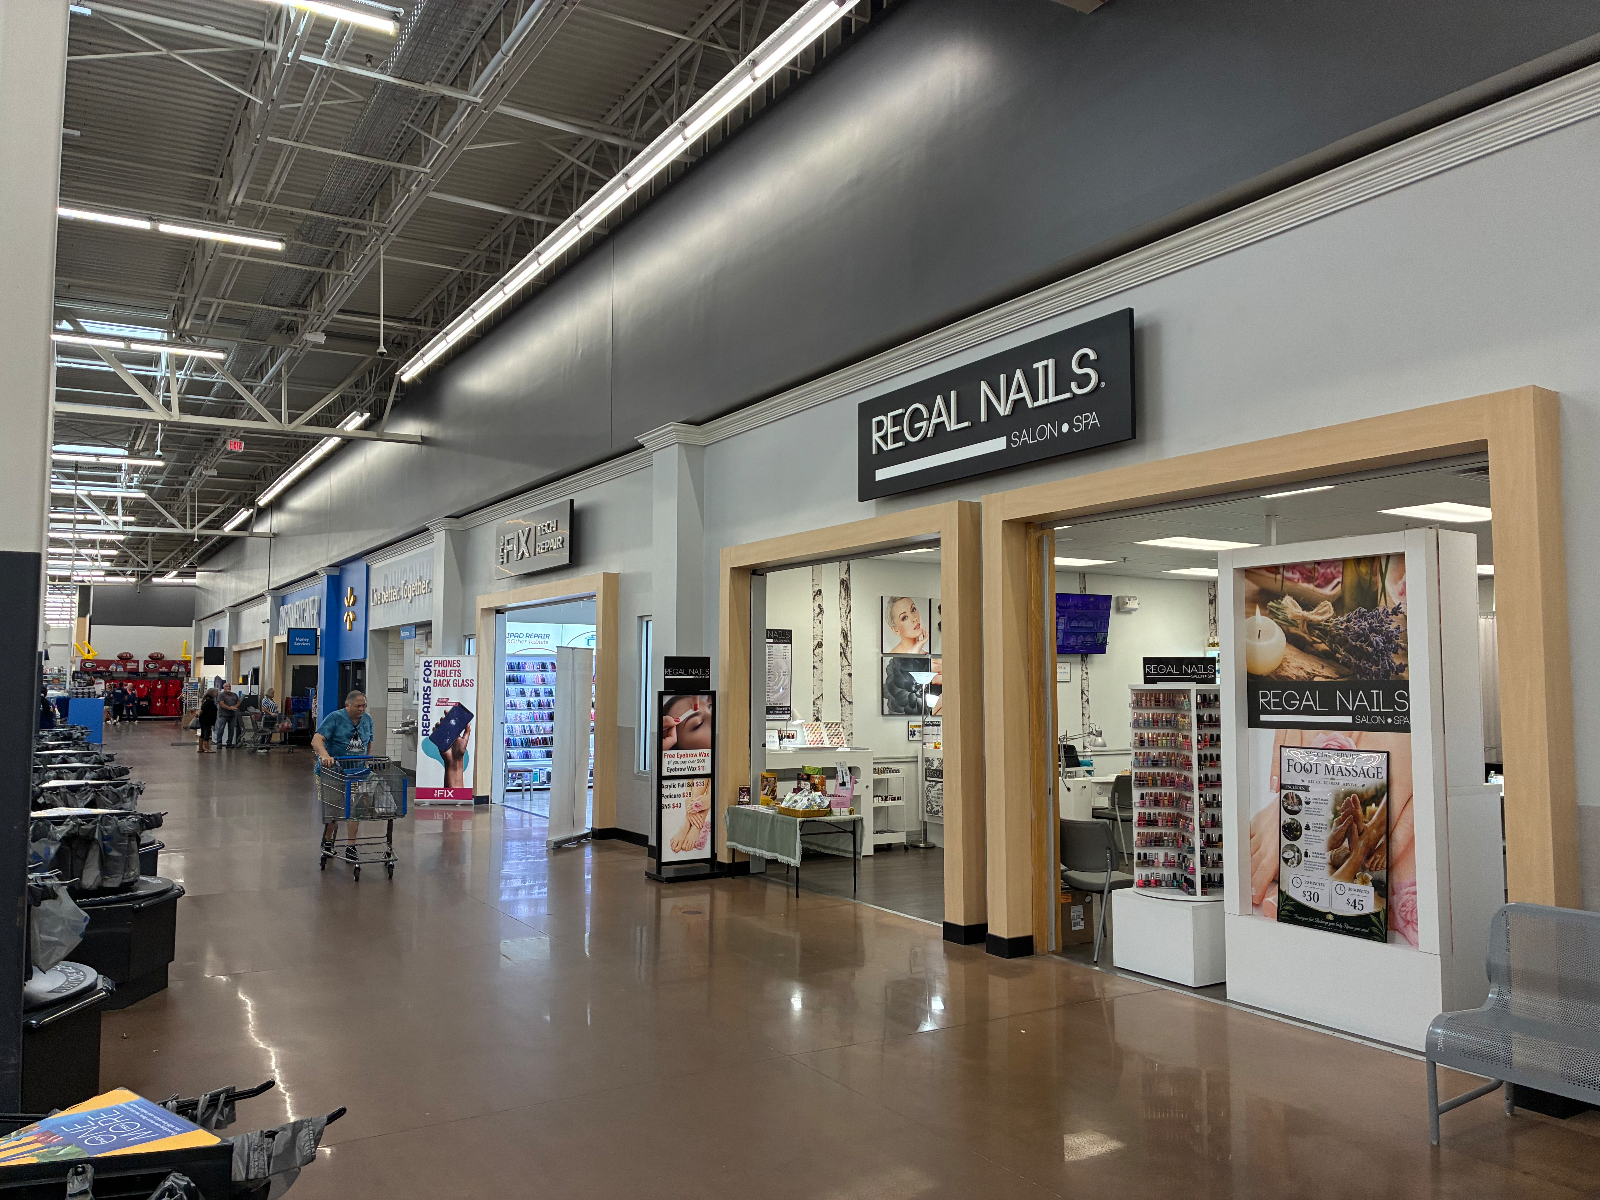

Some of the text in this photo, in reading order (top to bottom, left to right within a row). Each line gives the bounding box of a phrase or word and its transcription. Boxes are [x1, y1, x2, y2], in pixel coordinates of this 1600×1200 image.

[872, 390, 972, 455] REGAL
[1010, 411, 1100, 448] SALON SPA
[229, 440, 243, 451] EXIT
[537, 519, 558, 536] TECH
[504, 526, 532, 564] FIX
[536, 535, 564, 554] REPAIR
[401, 577, 432, 603] Together.
[434, 660, 460, 668] PHONES
[1146, 664, 1214, 674] REGAL NAILS
[434, 670, 461, 678] TABLETS
[433, 679, 474, 688] BACK GLASS
[422, 660, 432, 737] REPAIRS FOR
[1258, 690, 1409, 712] REGAL NAILS
[1355, 715, 1410, 725] SALON SPA
[1286, 759, 1384, 780] FOOT MASSAGE
[438, 790, 454, 798] FIX
[1302, 890, 1320, 904] $30
[1346, 898, 1364, 912] $45
[60, 1120, 117, 1146] ONE
[88, 1109, 158, 1142] MORE
